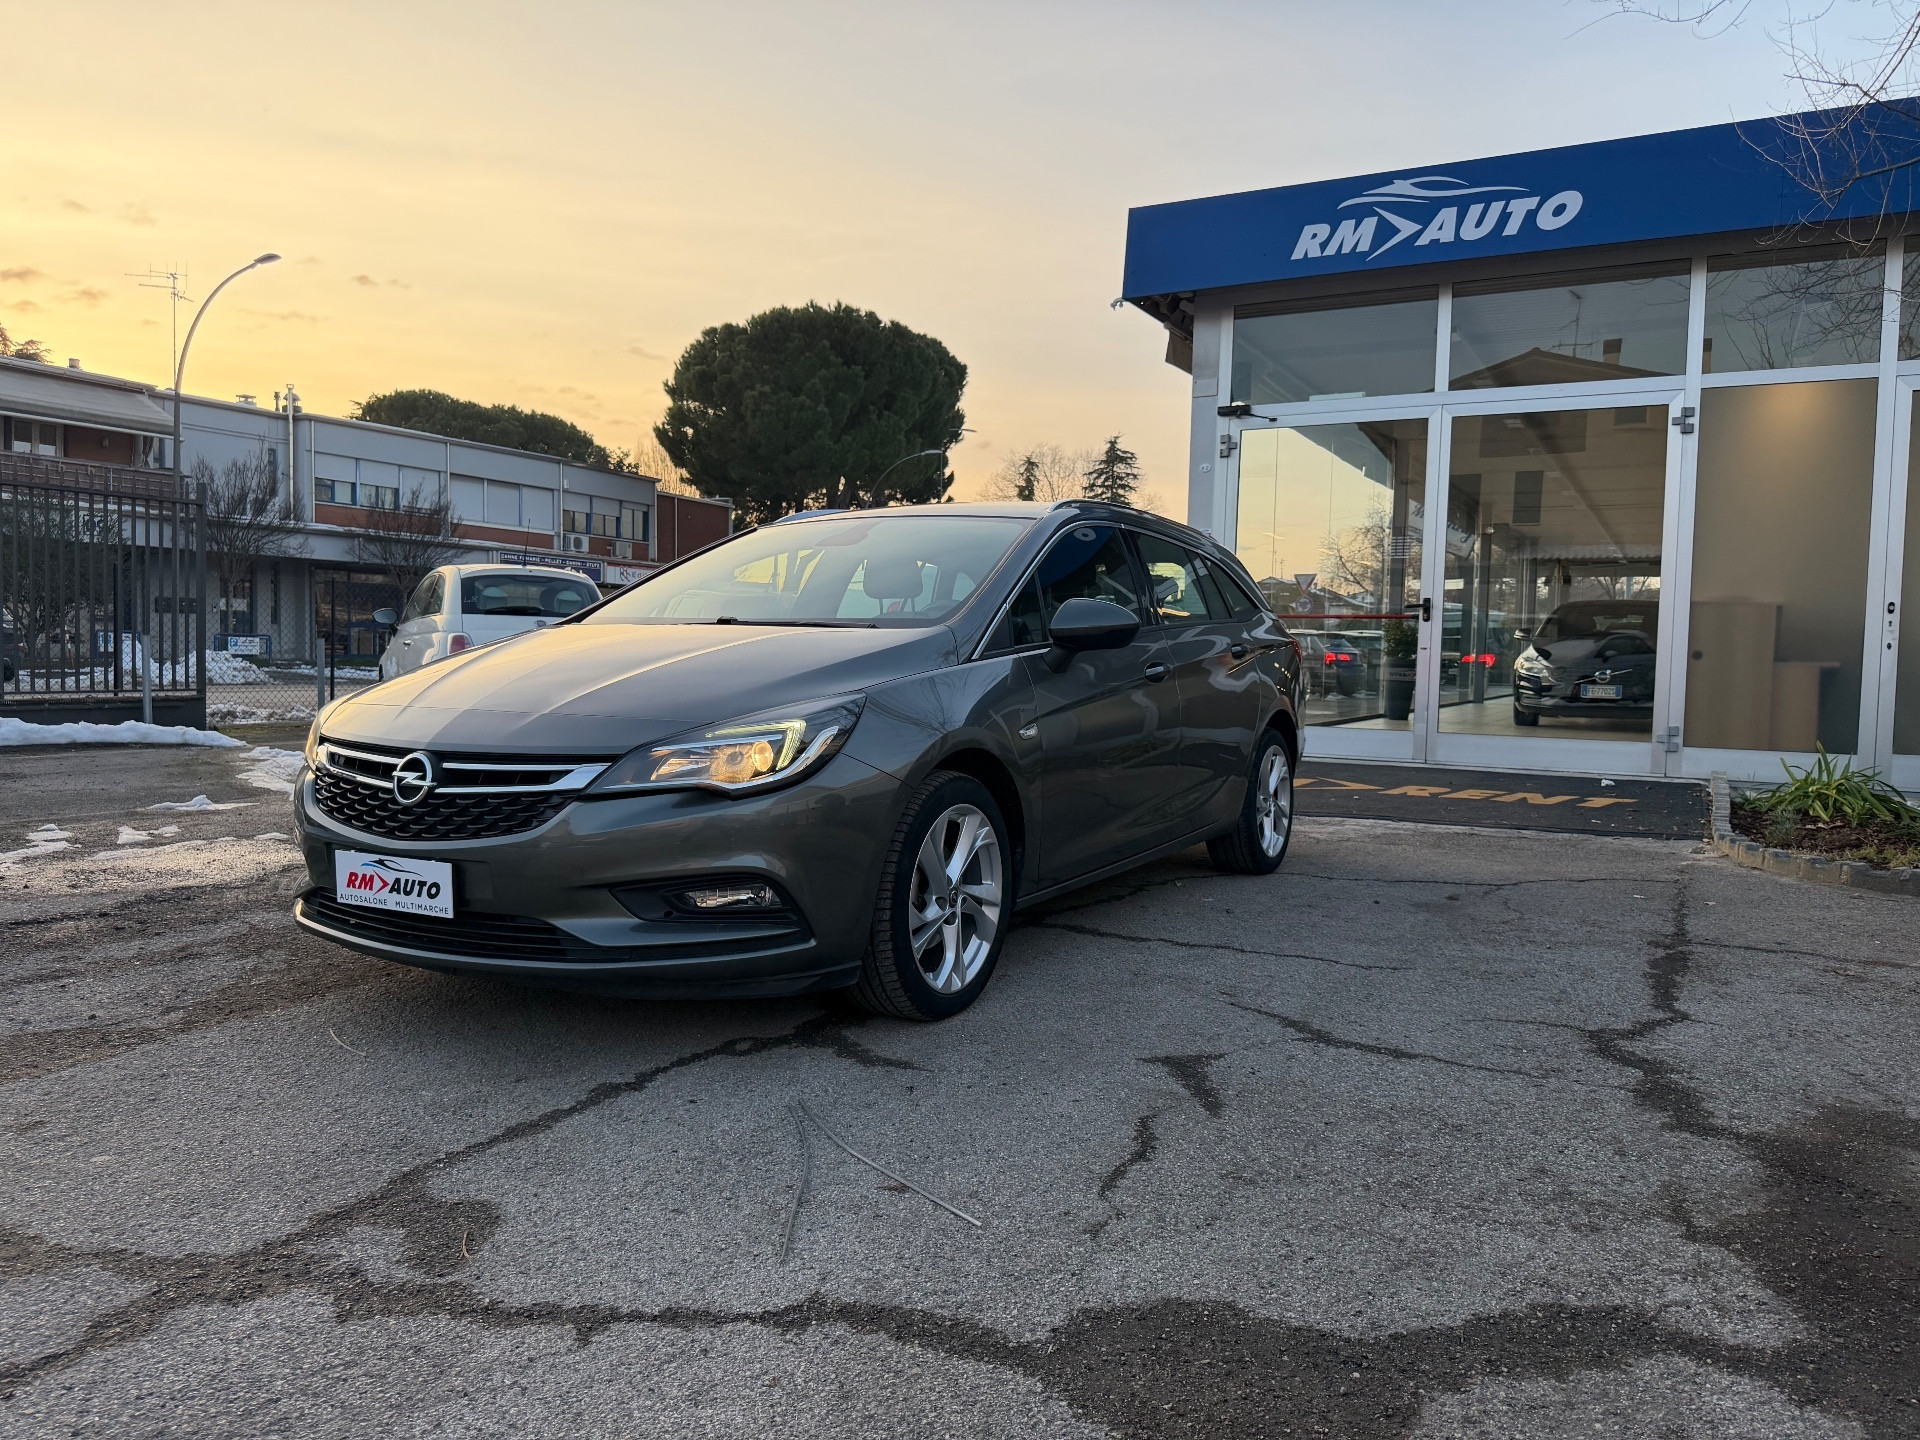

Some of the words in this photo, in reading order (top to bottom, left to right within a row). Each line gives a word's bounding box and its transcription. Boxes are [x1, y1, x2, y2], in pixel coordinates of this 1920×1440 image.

[1290, 216, 1378, 260] RM
[1413, 190, 1584, 246] AUTO
[1378, 785, 1639, 808] RENT
[346, 871, 375, 891] RM
[388, 877, 441, 900] AUTO
[340, 893, 388, 906] AUTOSALONE
[395, 900, 449, 915] MULTIMARCHE
